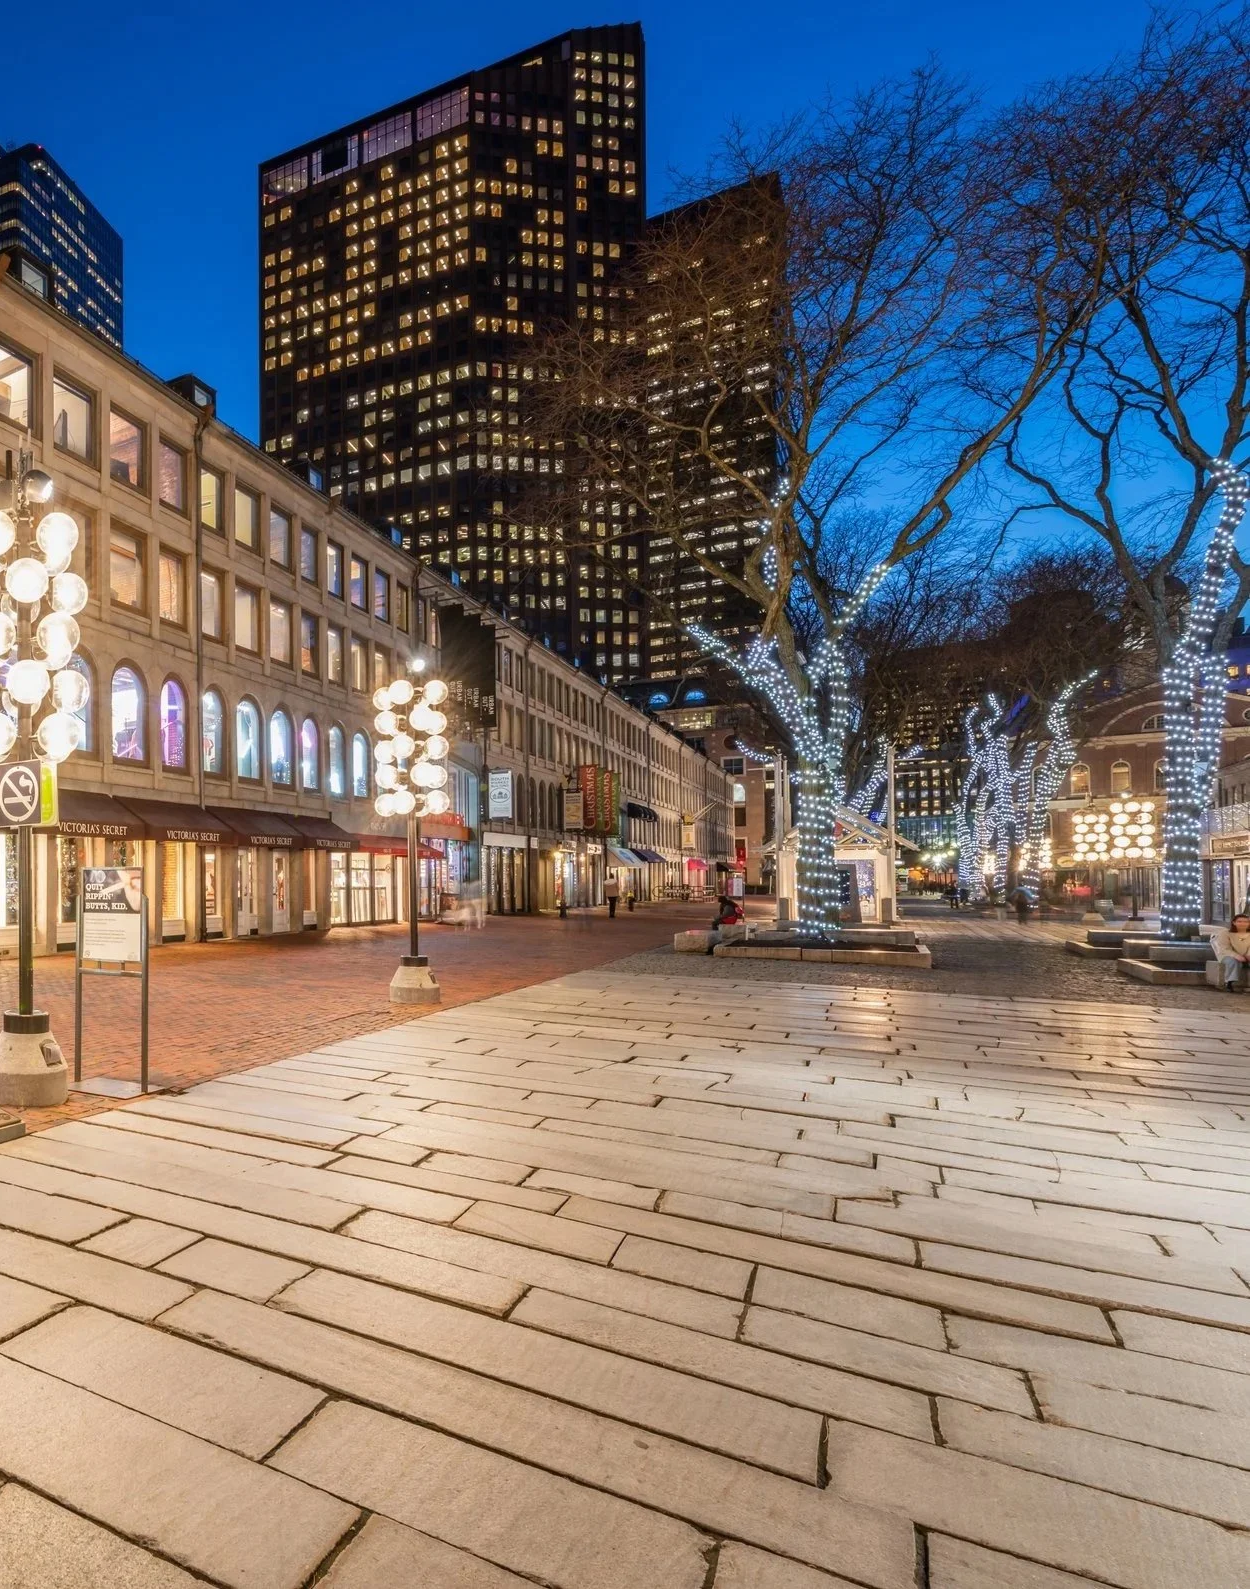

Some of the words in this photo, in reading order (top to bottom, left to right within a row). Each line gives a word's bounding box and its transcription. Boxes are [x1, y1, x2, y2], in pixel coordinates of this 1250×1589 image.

[583, 767, 596, 829] CHRISTMAS
[58, 822, 100, 834] VICTORIA'S
[102, 825, 128, 836] SECRET
[167, 830, 199, 841] VICTORIA'S
[200, 832, 220, 842] SECRET
[250, 836, 276, 845] VICTORIA'S
[276, 837, 293, 846] SECRET
[316, 839, 337, 848] VICTORIA'S
[337, 840, 351, 849] SECRET
[85, 902, 110, 911] BUTTS,
[111, 902, 128, 910] KID.
